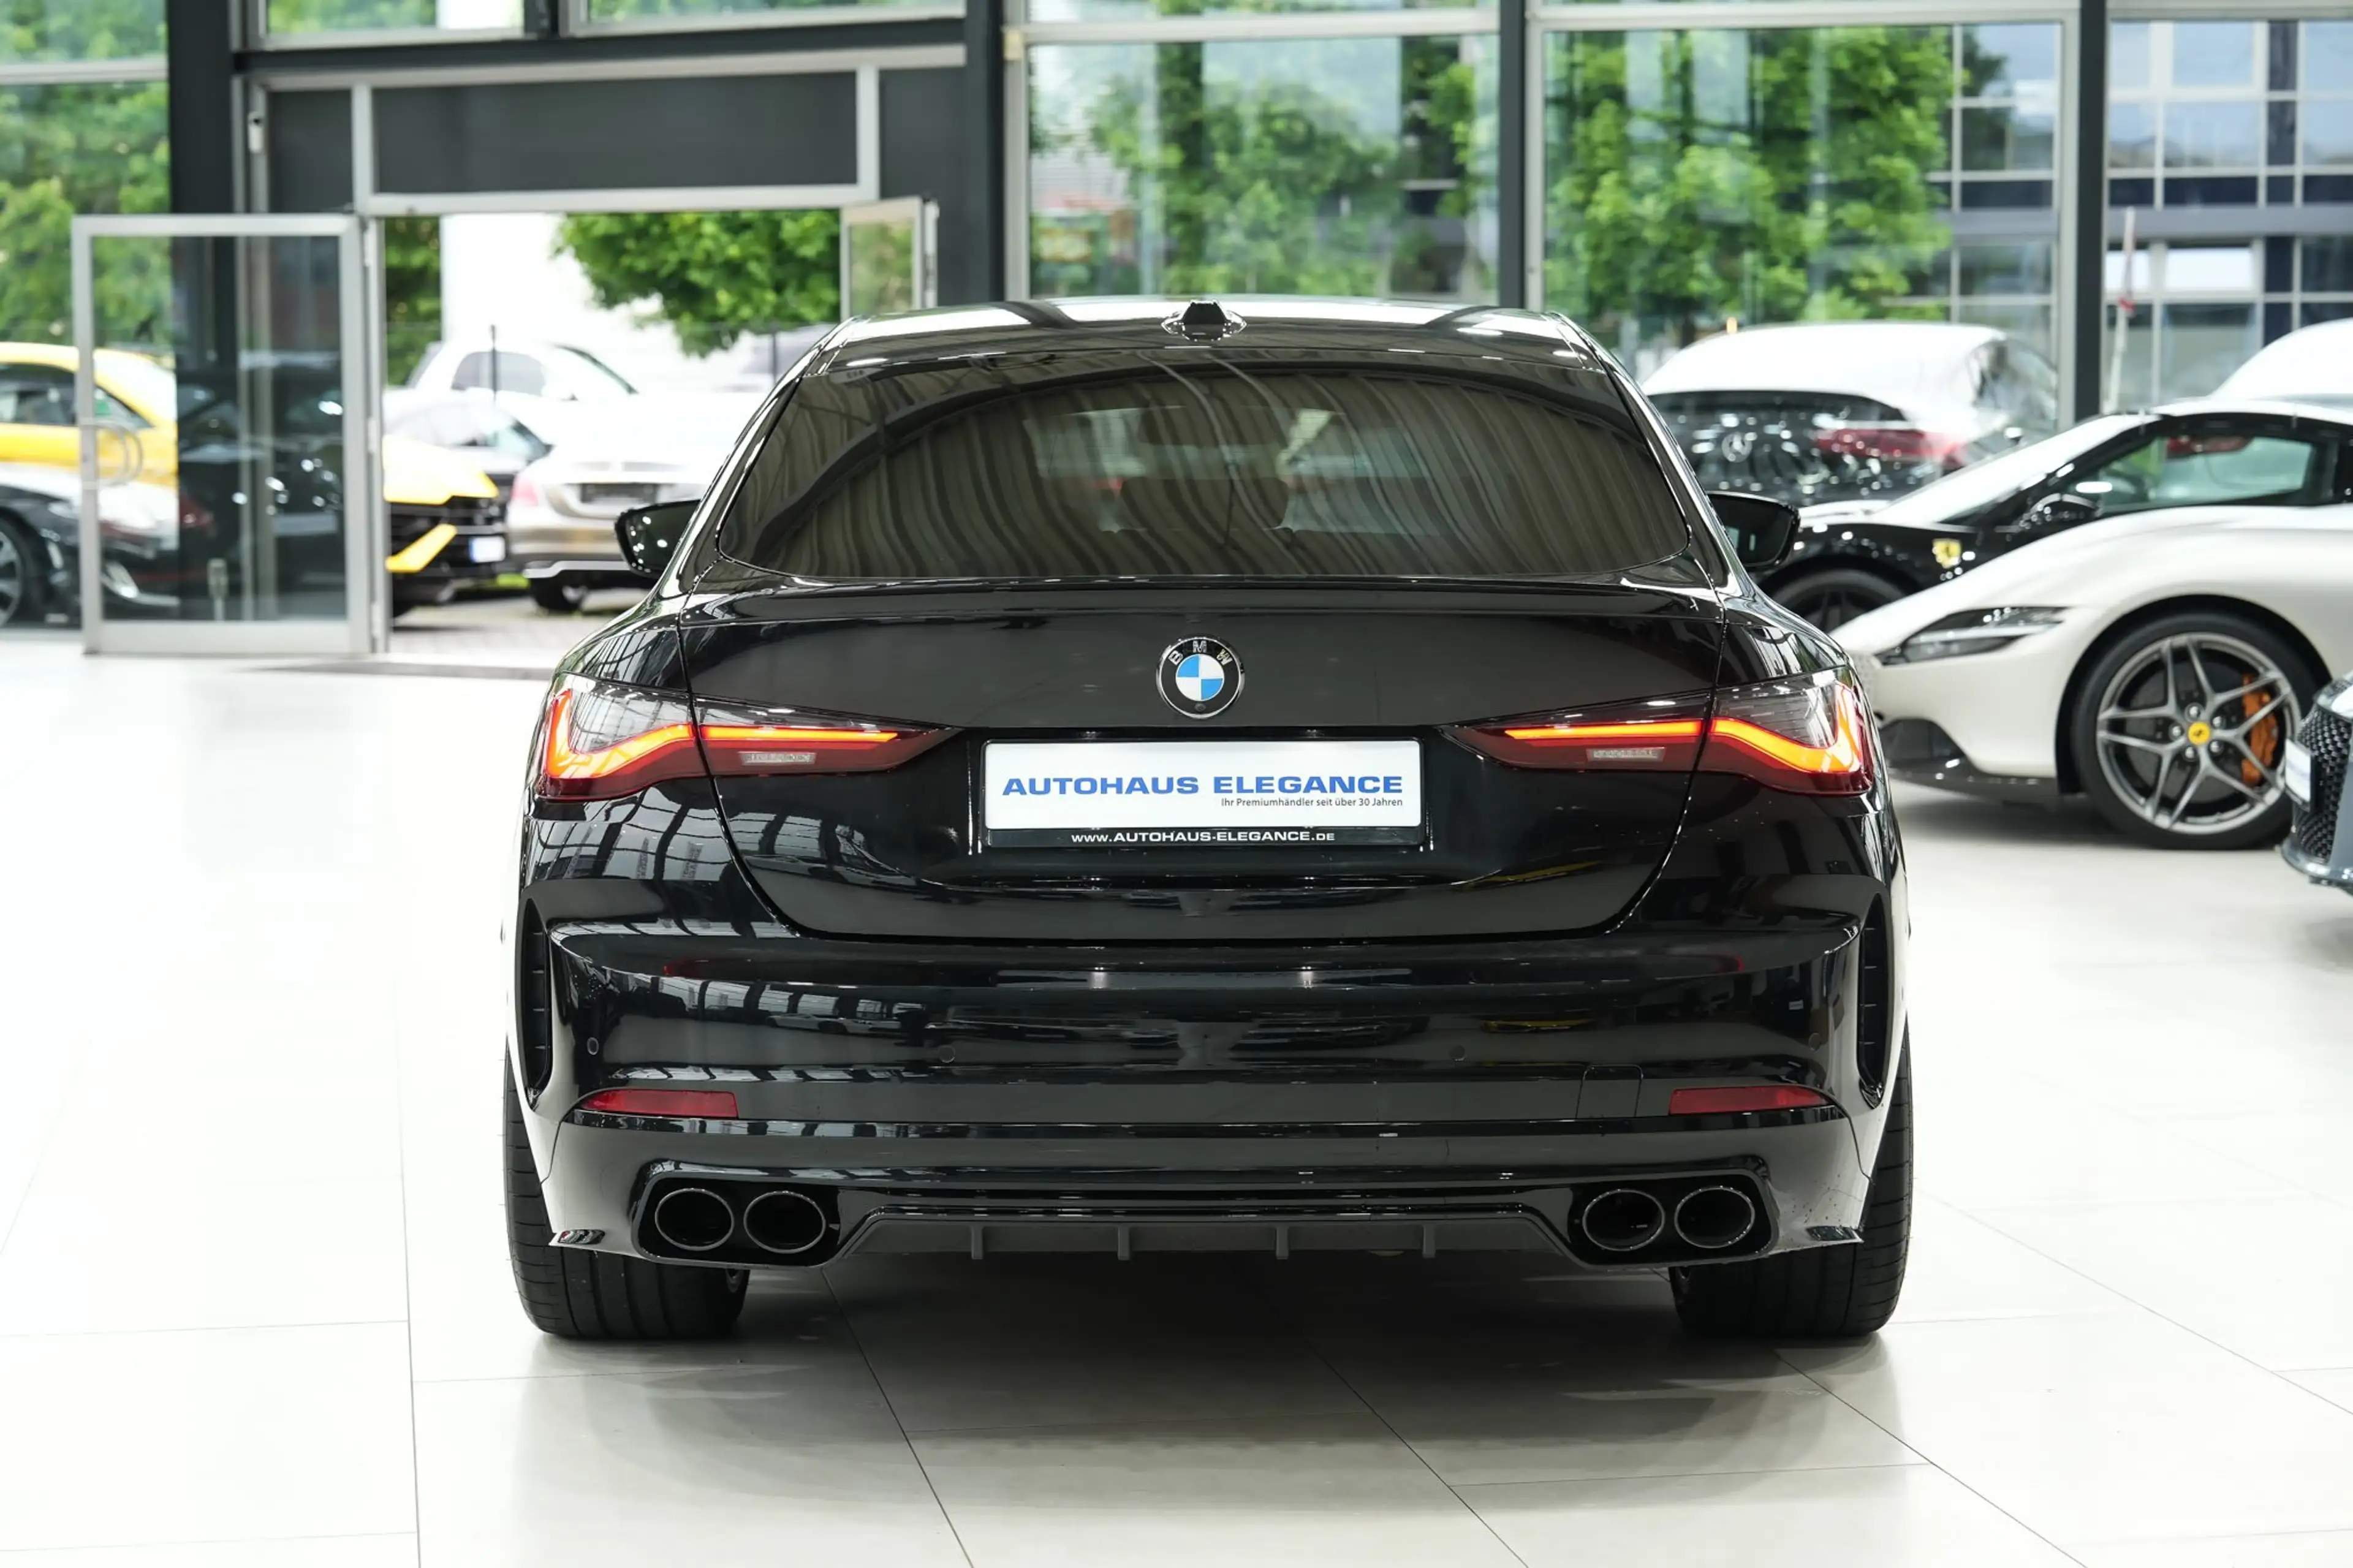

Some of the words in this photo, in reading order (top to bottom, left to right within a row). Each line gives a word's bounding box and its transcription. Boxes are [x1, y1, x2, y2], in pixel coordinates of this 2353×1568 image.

[1168, 640, 1233, 665] BMW
[1002, 776, 1199, 796] AUTOHAUS
[1213, 776, 1403, 793] ELEGANCE
[1221, 798, 1234, 806] Ihr
[1237, 798, 1314, 806] Premiumhändler
[1316, 798, 1332, 806] seit
[1335, 798, 1356, 806] über
[1358, 798, 1370, 806] 30
[1371, 798, 1403, 806] Jahren
